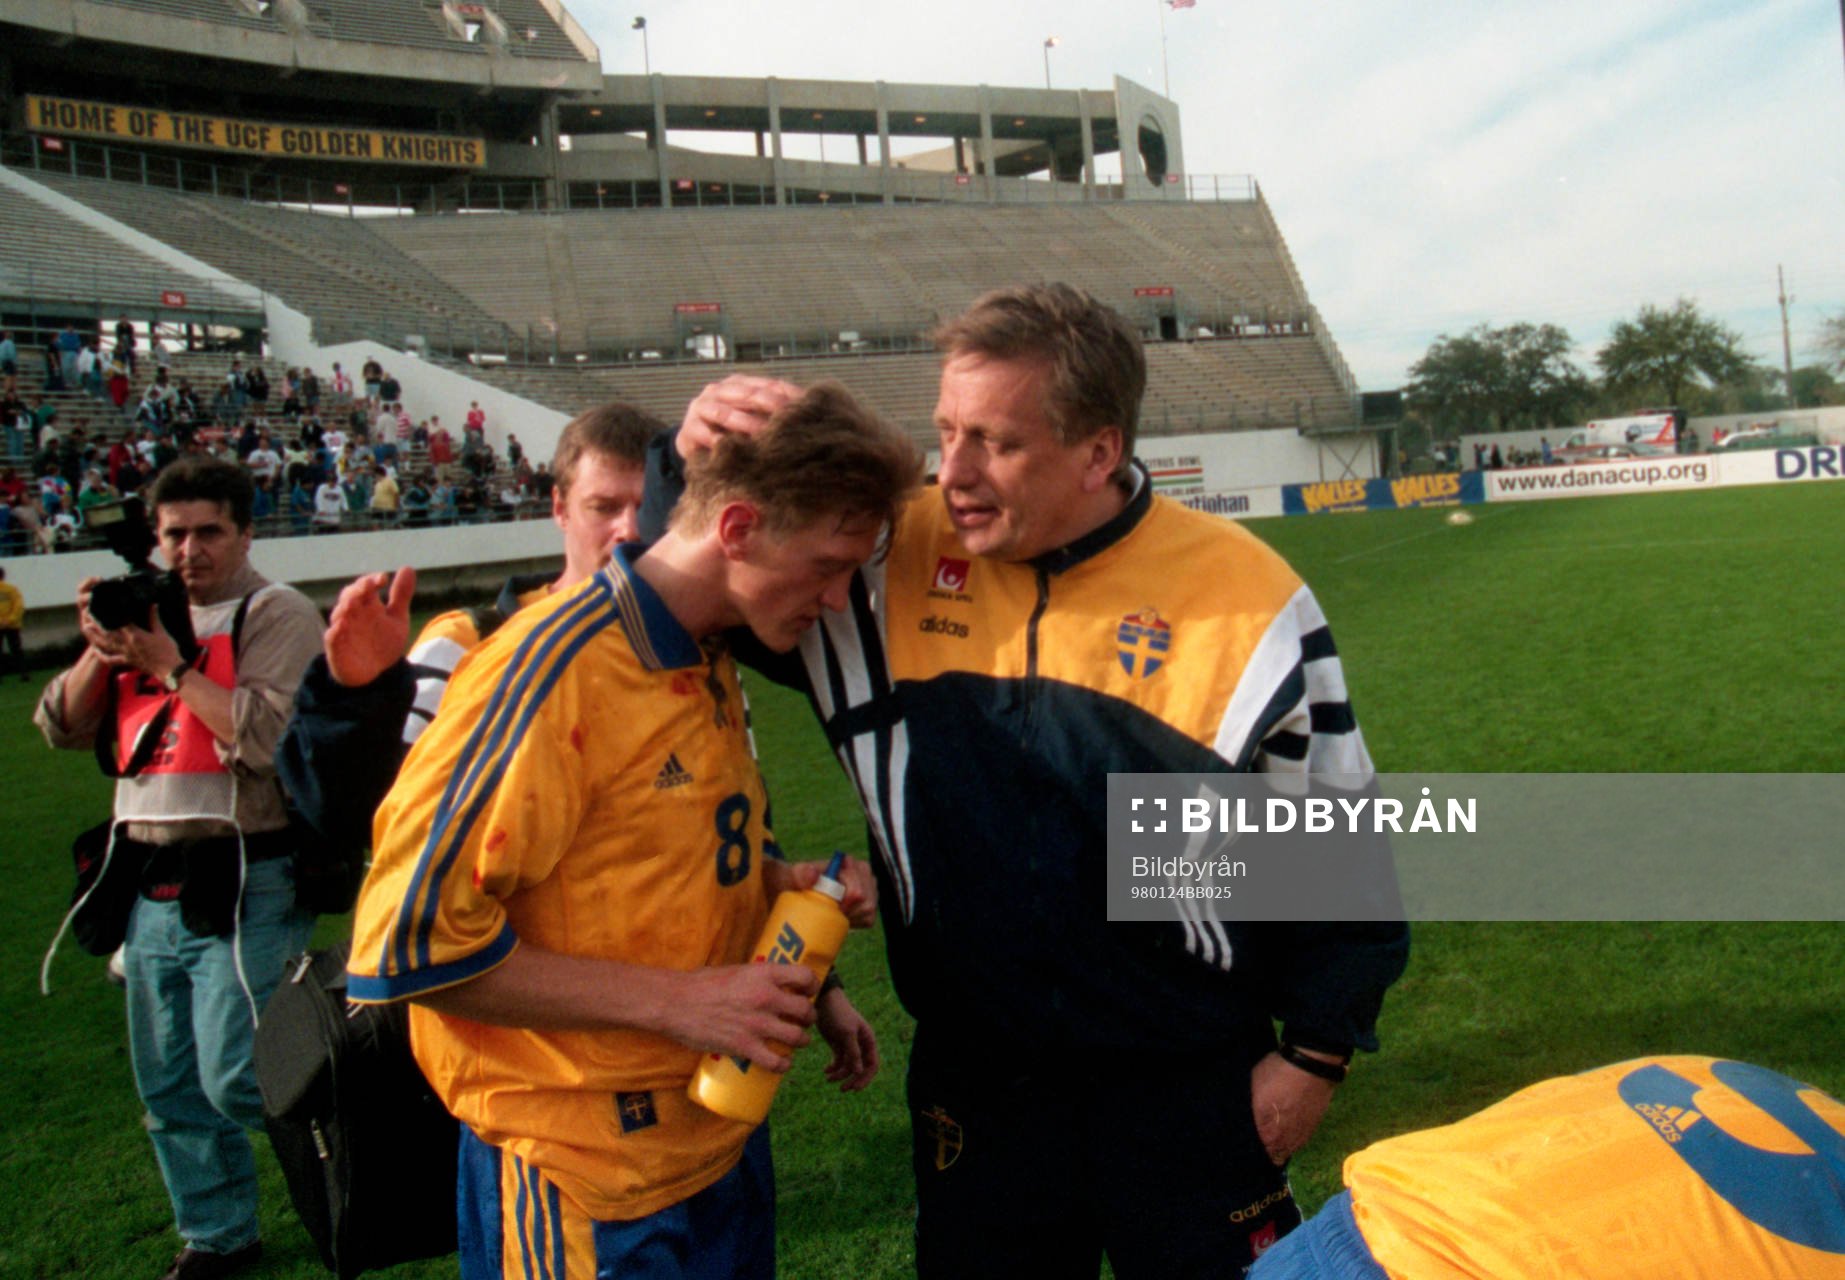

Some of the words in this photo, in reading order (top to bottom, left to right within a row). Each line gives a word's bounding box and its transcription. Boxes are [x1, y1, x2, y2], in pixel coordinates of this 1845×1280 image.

[39, 99, 117, 134] HOME
[129, 109, 158, 137] OF
[170, 115, 214, 145] THE
[225, 122, 271, 149] UCF
[281, 129, 371, 157] GOLDEN
[382, 135, 477, 163] KNIGHTS
[1498, 463, 1707, 491] www.danacup.org
[1775, 446, 1845, 479] DR
[919, 614, 970, 639] adidas
[654, 772, 694, 789] adidas
[714, 792, 751, 887] 8
[1634, 1103, 1681, 1142] adidas
